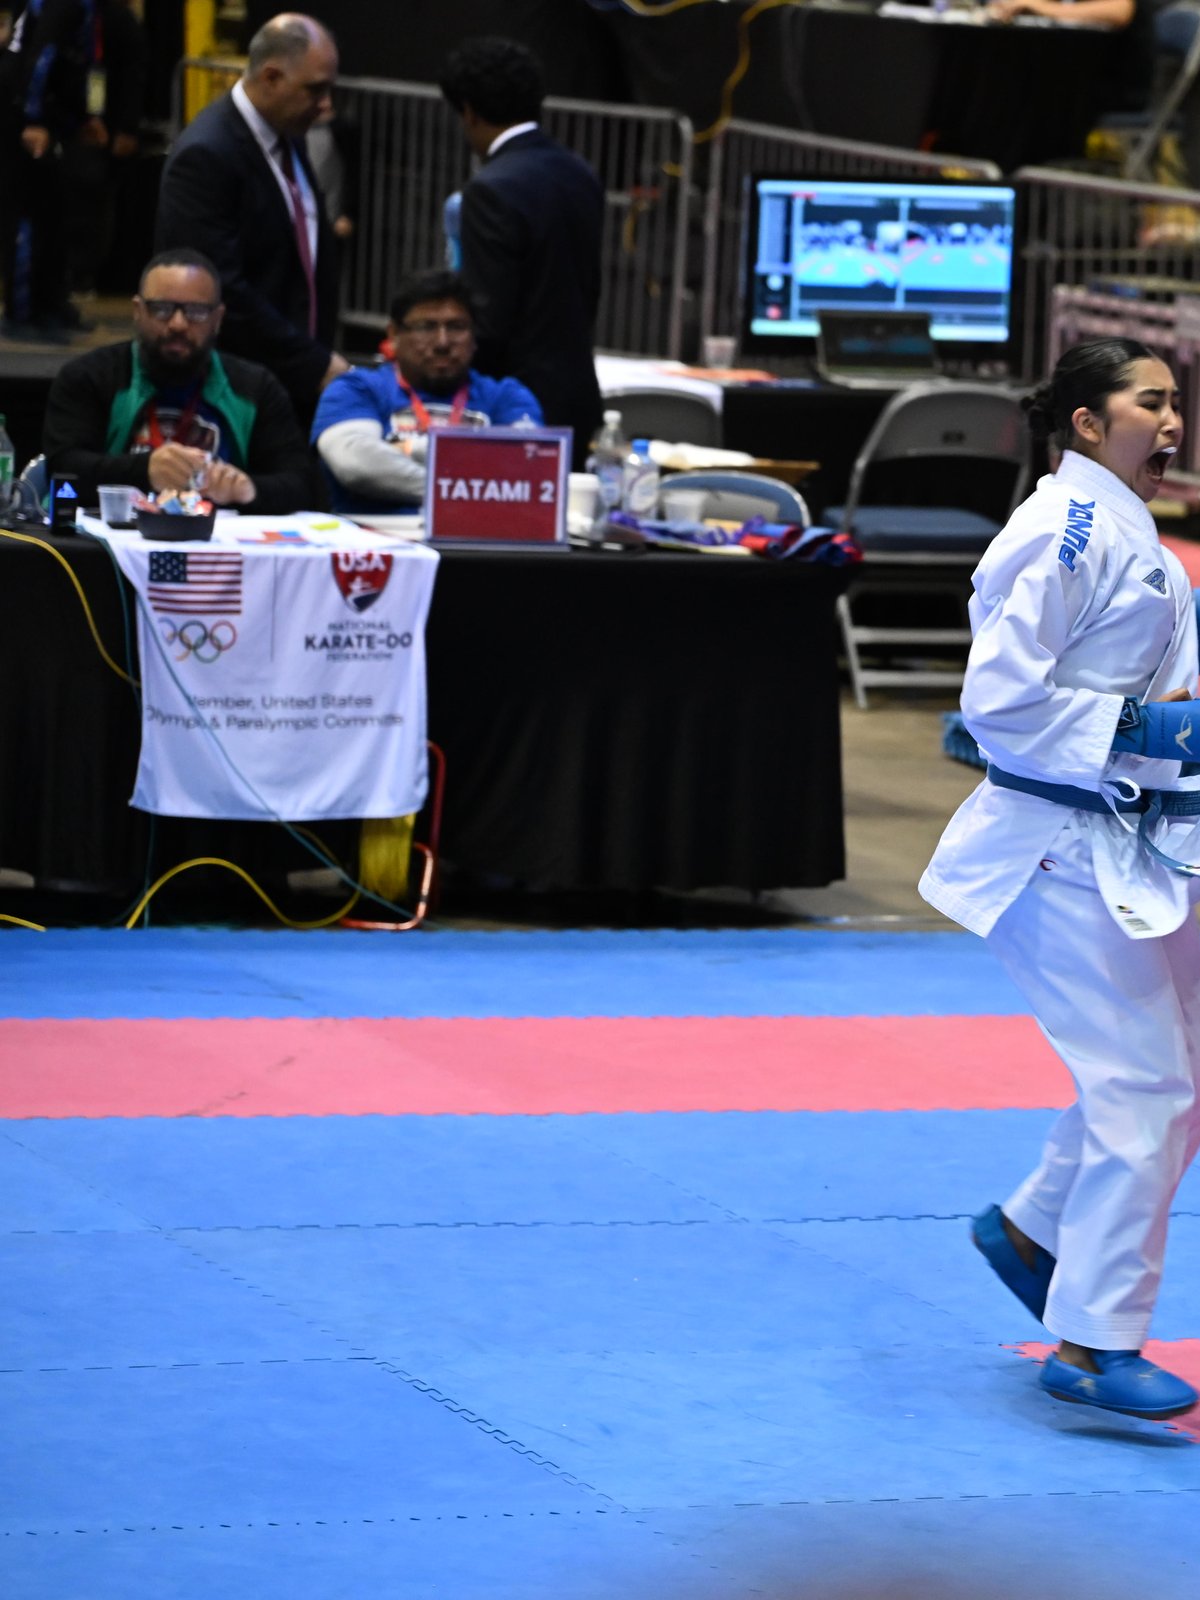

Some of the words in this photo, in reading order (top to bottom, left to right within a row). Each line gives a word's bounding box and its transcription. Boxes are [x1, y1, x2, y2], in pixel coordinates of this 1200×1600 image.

[437, 477, 531, 502] TATAMI
[538, 479, 556, 504] 2
[339, 551, 387, 573] USA
[193, 695, 254, 711] ember,
[261, 694, 316, 711] United
[320, 692, 374, 710] States
[225, 714, 319, 732] Paralympic
